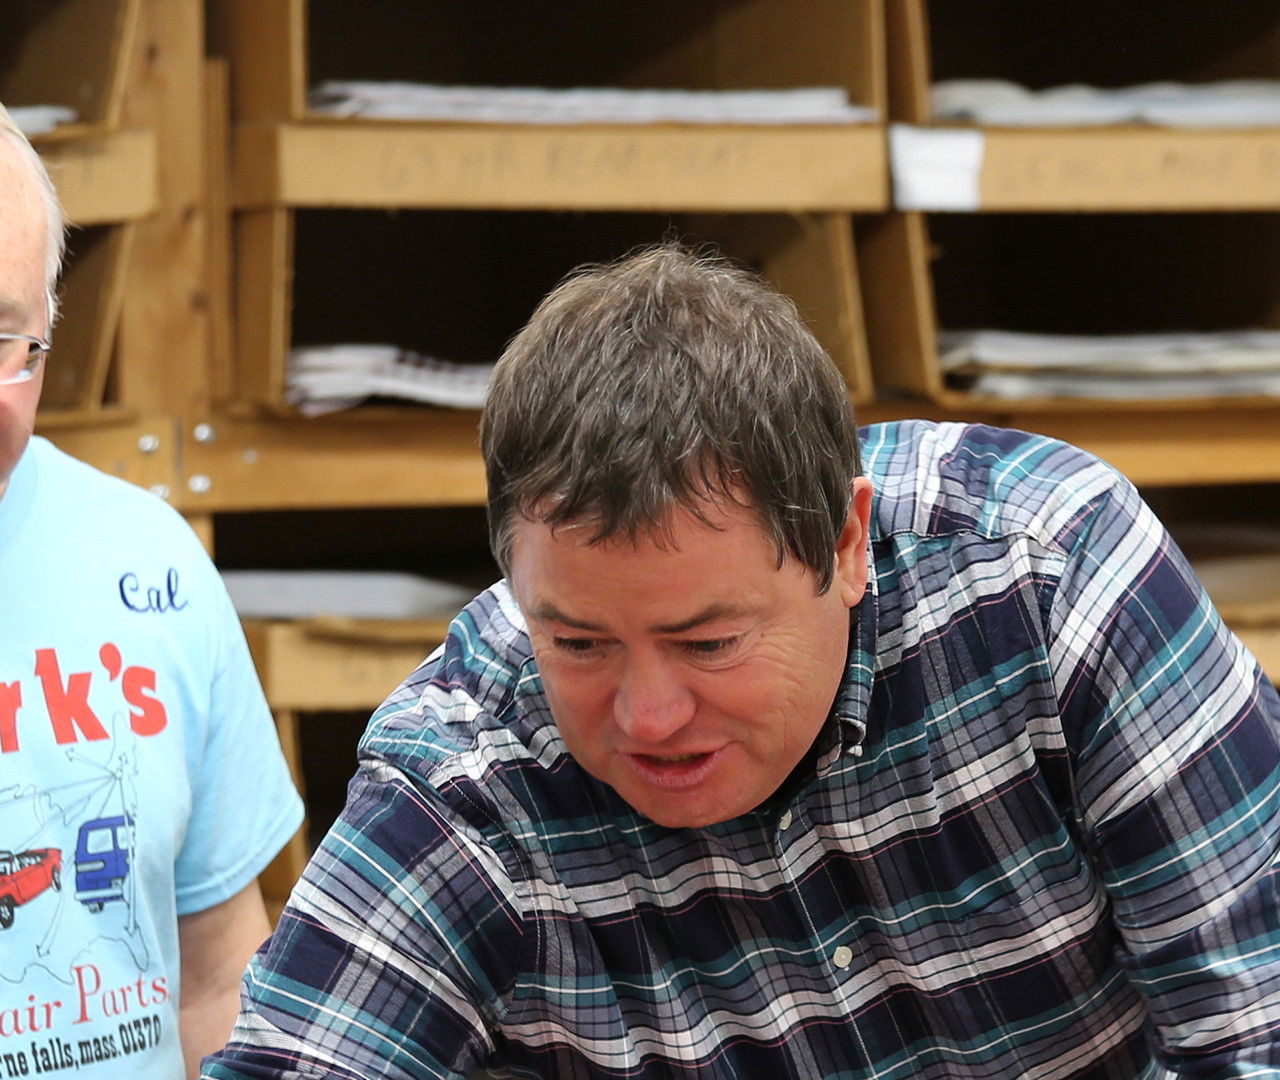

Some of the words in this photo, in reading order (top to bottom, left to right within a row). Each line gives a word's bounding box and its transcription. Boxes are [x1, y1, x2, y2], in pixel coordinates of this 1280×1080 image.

[119, 567, 187, 614] Cal
[72, 963, 169, 1025] Parts
[118, 1013, 161, 1055] 01370
